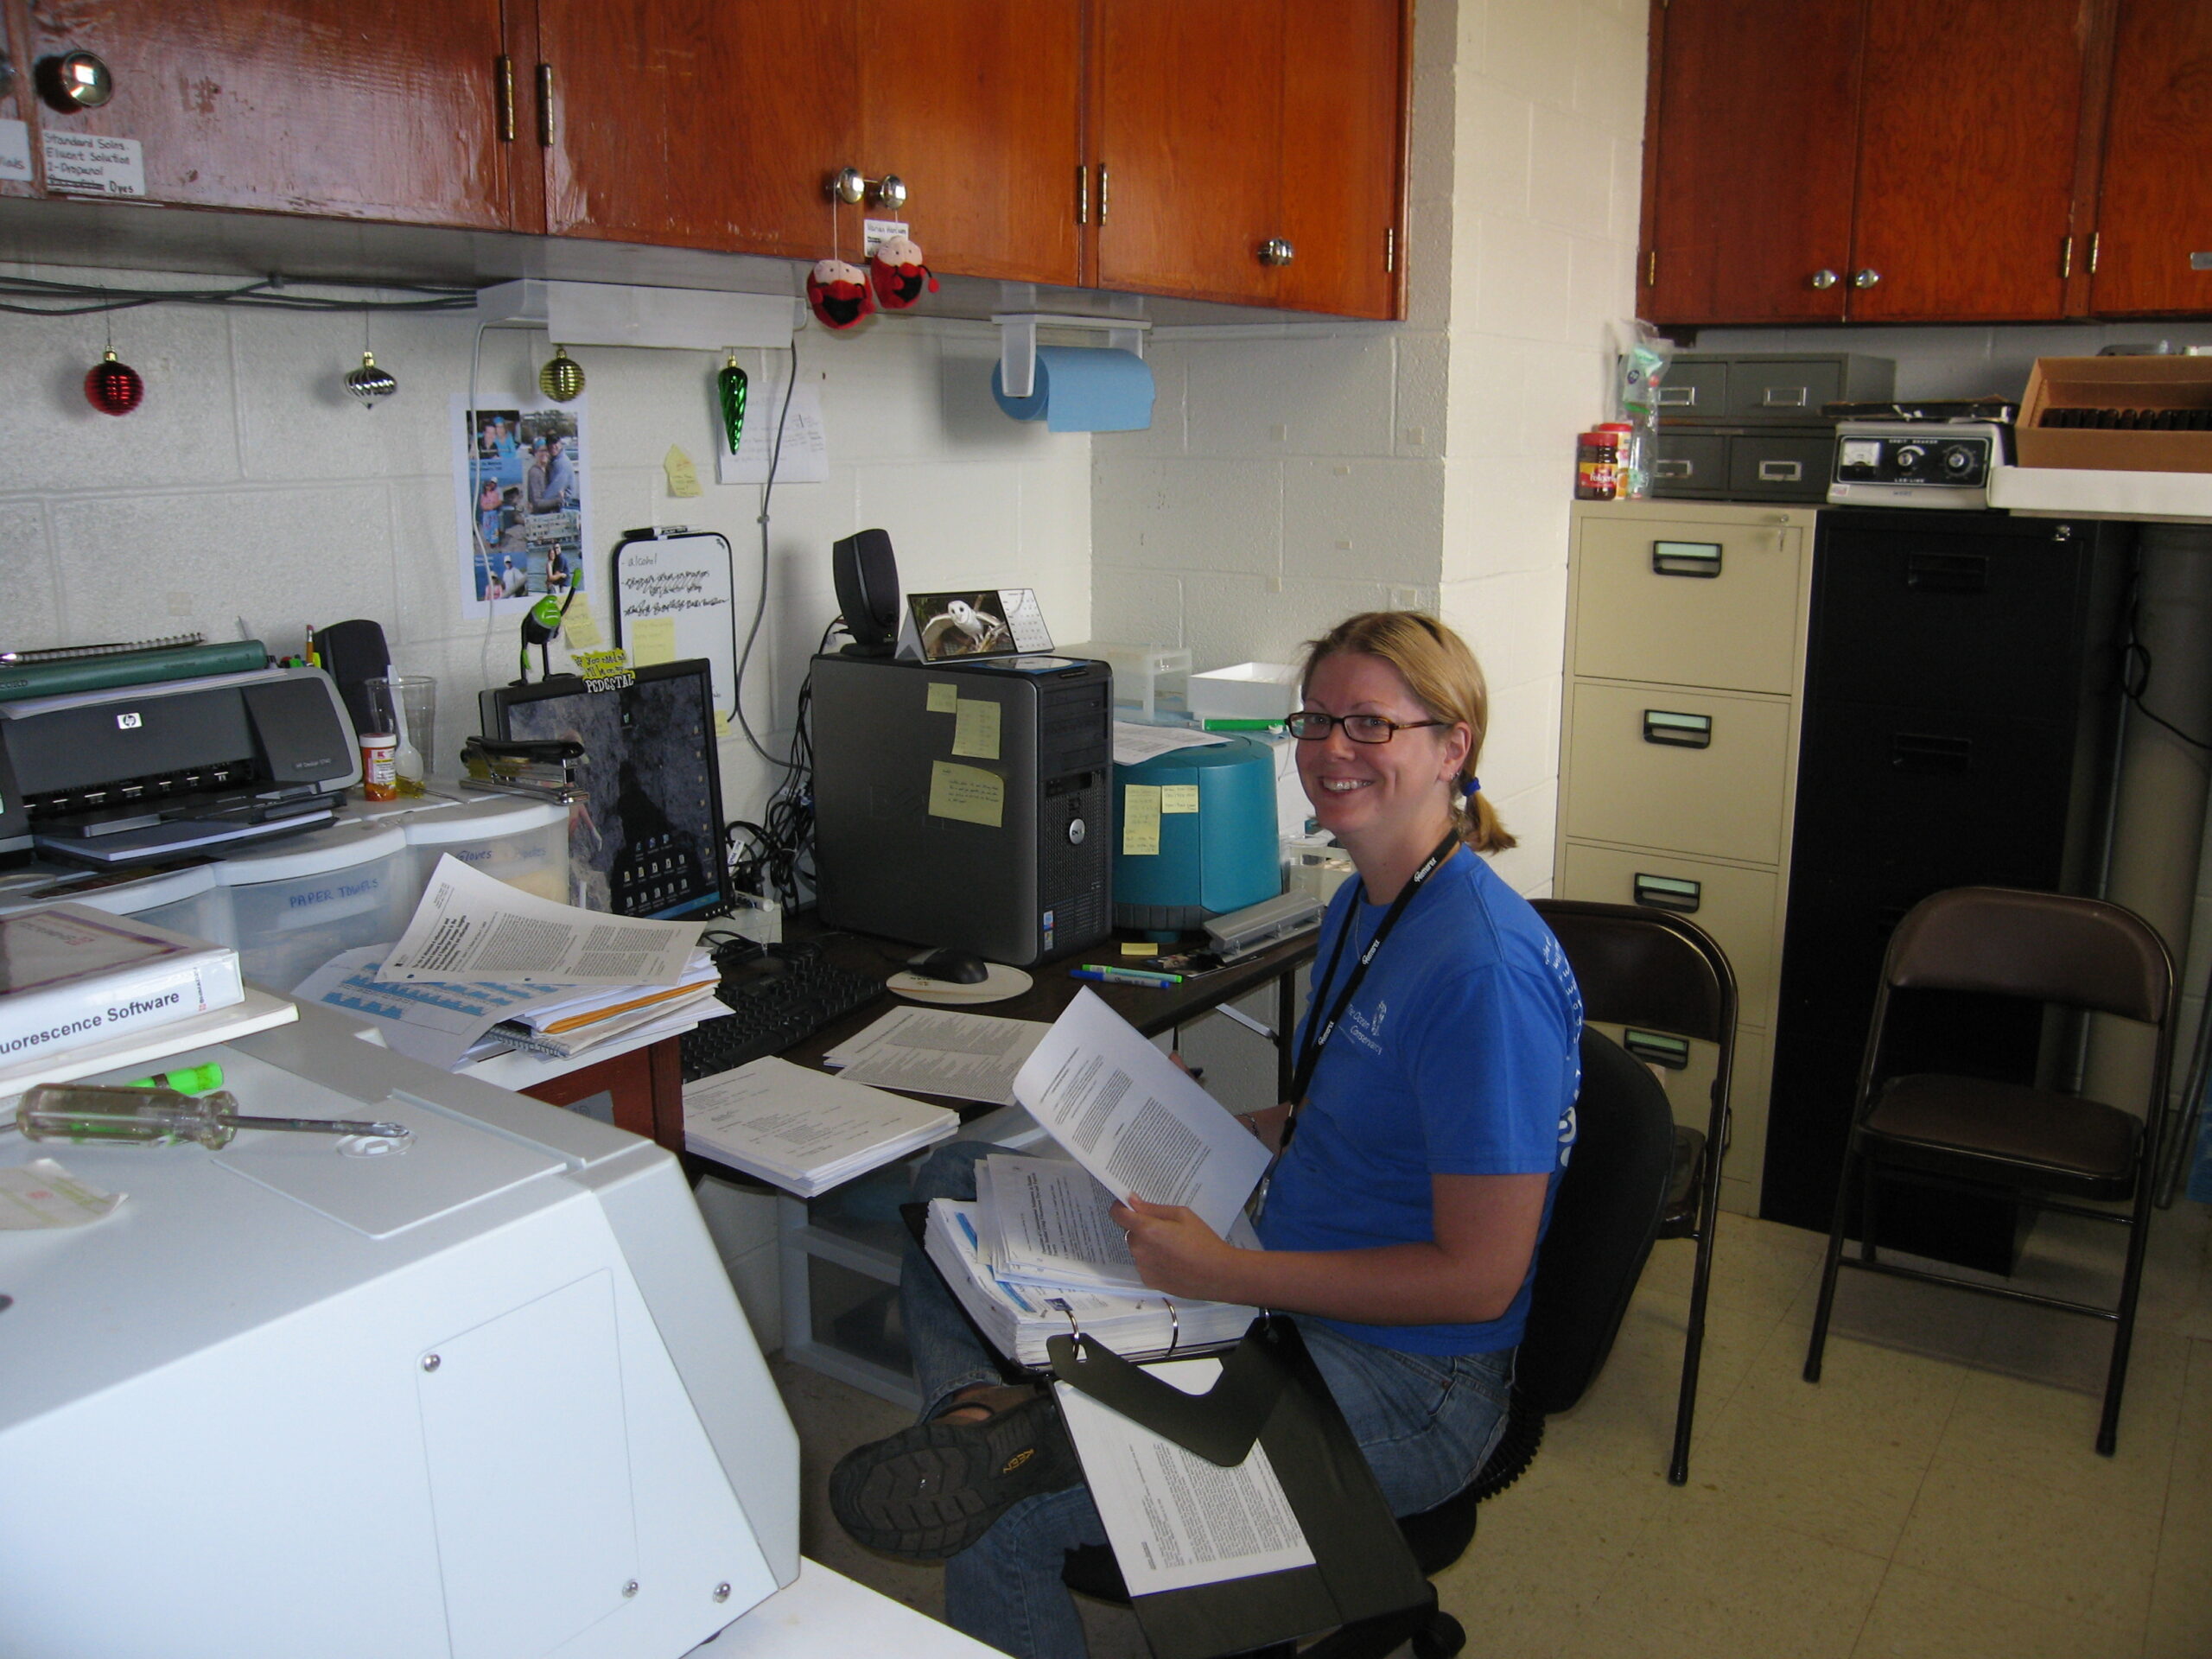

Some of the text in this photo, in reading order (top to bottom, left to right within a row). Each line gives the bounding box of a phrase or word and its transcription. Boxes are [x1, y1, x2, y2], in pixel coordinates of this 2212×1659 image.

[90, 152, 130, 165] Solution
[108, 180, 134, 194] Dyes
[627, 553, 658, 568] alcohol
[585, 673, 634, 693] PEDESTAL
[289, 879, 378, 908] PAPER TOWELS
[107, 993, 180, 1021] Software
